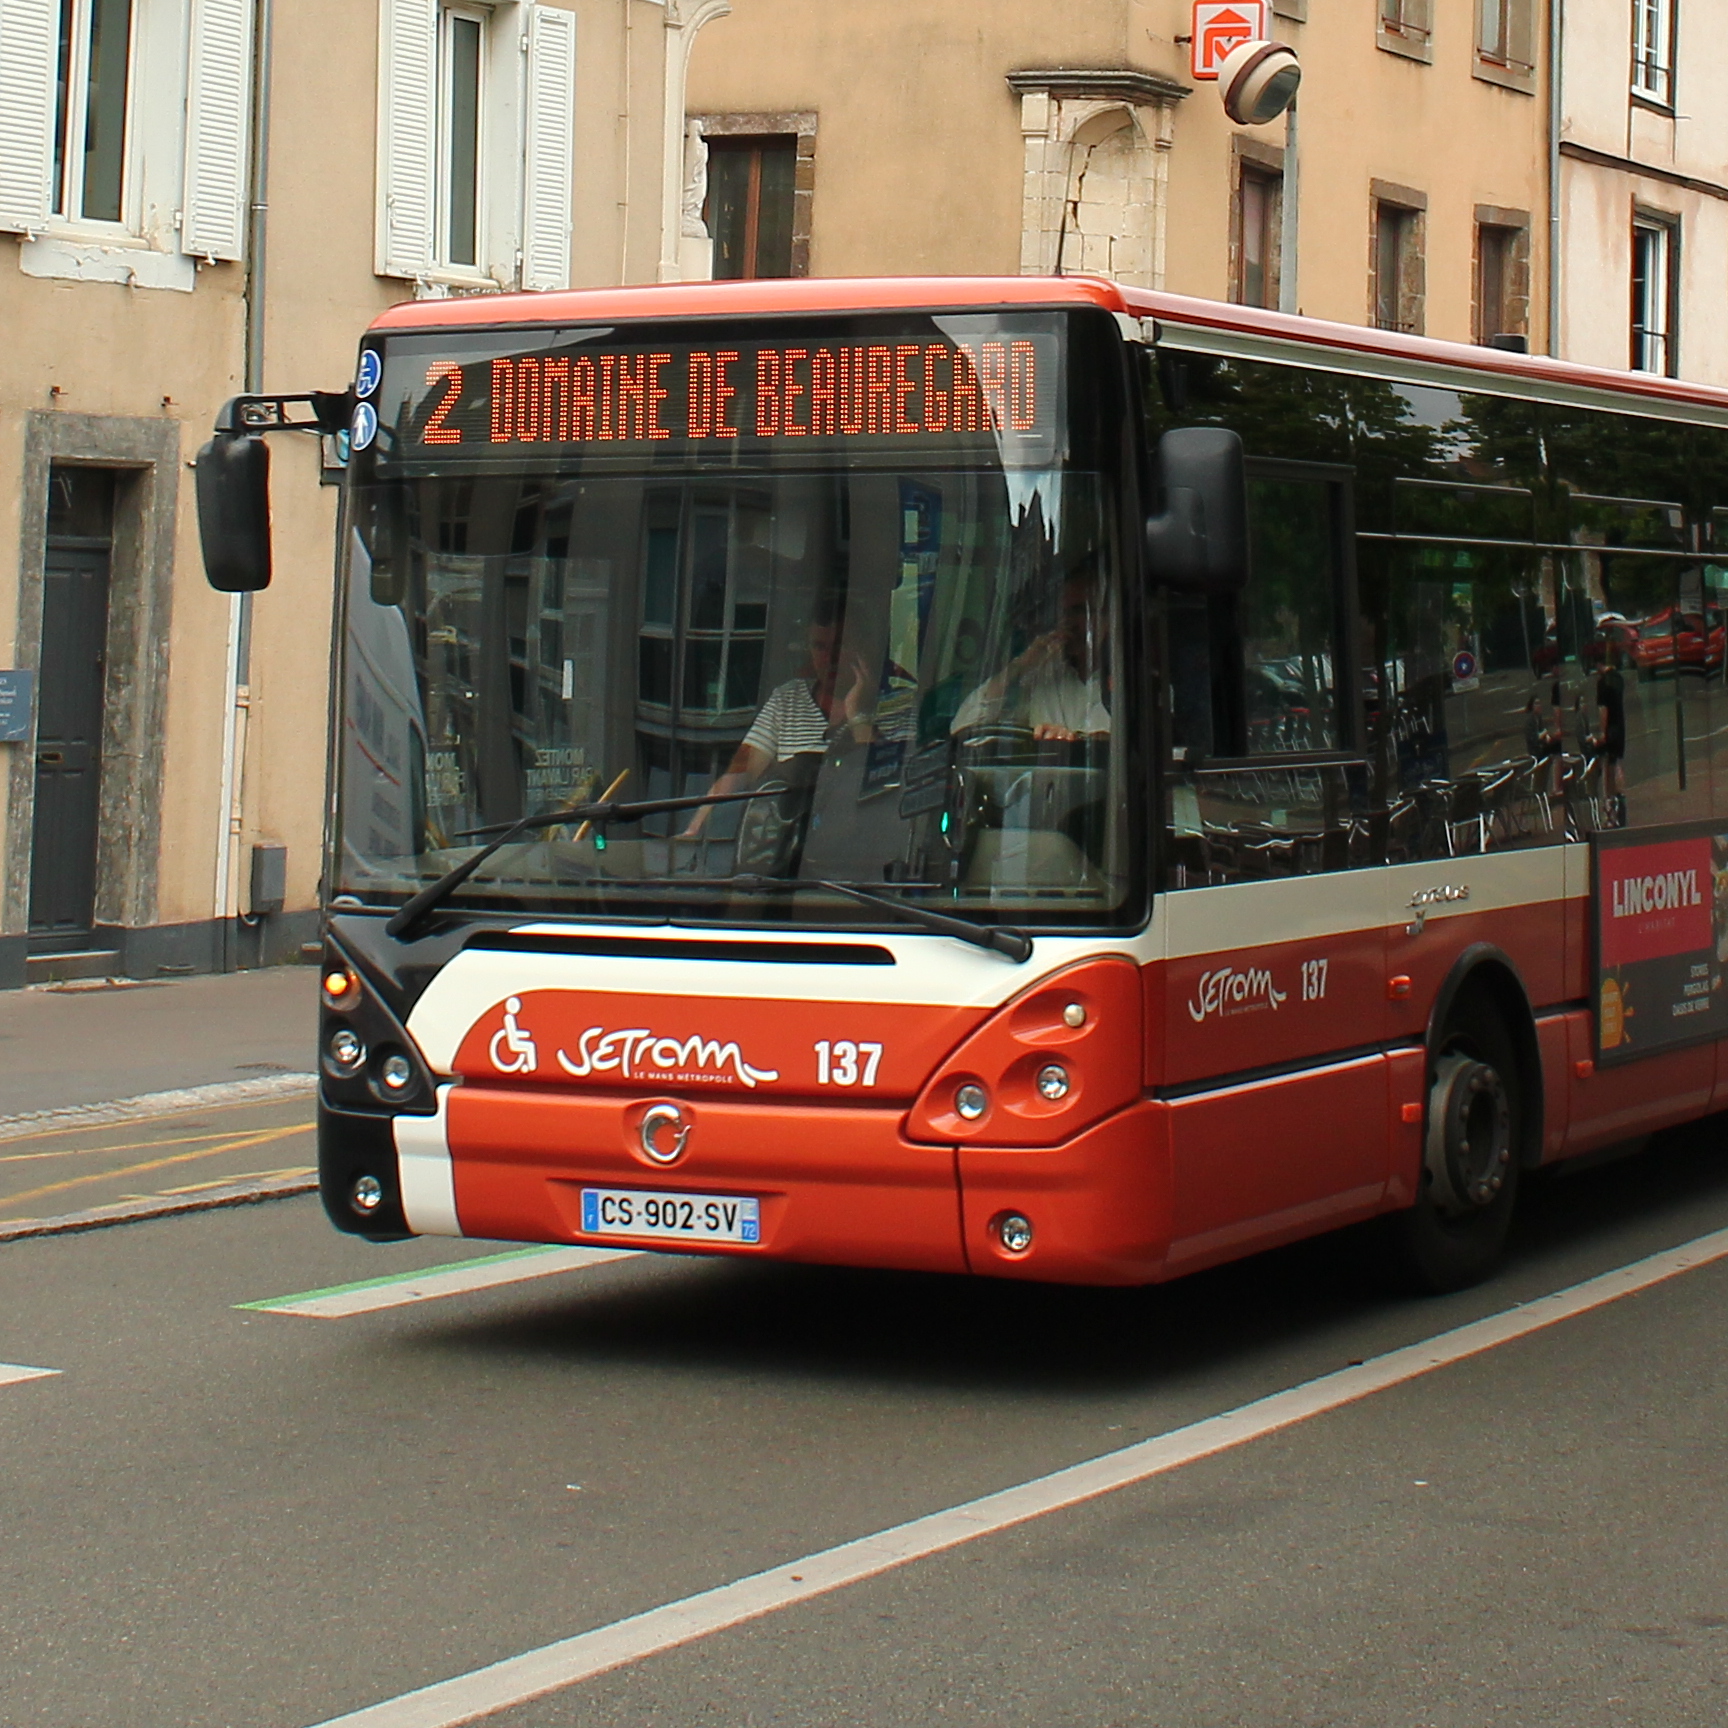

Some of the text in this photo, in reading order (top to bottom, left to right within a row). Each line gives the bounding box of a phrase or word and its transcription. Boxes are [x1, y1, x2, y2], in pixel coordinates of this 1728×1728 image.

[424, 341, 1036, 445] 2 DOMAINE DE BEAUREGARD
[1612, 869, 1702, 918] LINCONYL
[1301, 958, 1328, 1001] 137
[648, 1071, 674, 1081] MANS
[813, 1039, 884, 1087] 137
[601, 1195, 738, 1232] CS-902-SV
[743, 1223, 757, 1238] 72
